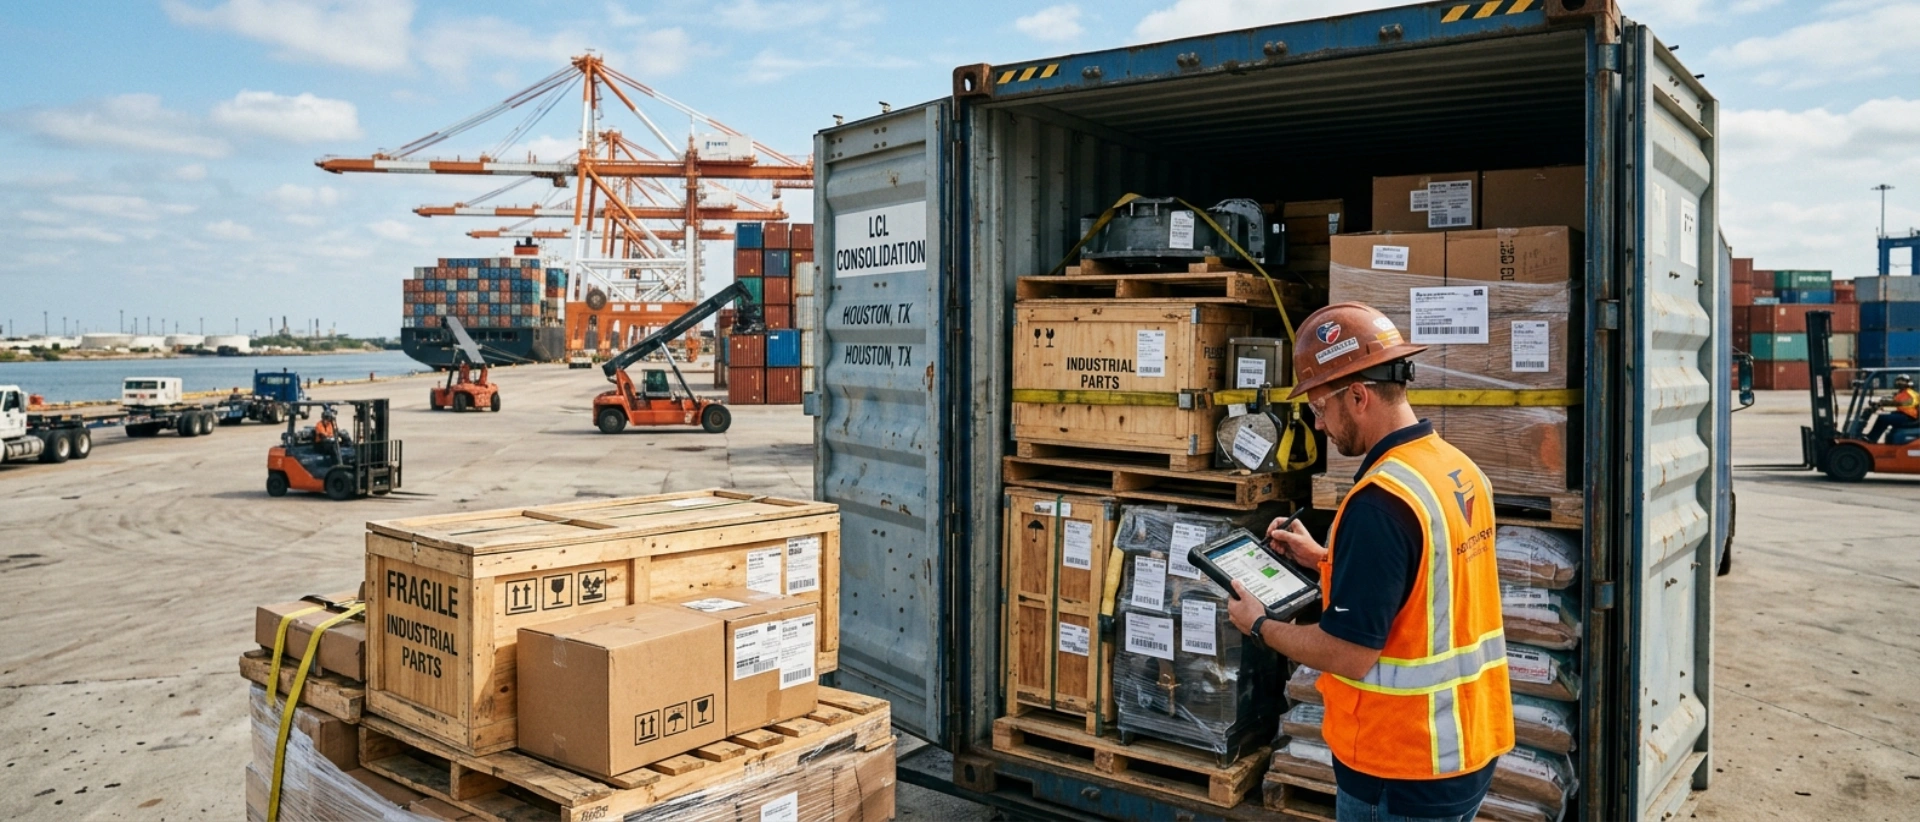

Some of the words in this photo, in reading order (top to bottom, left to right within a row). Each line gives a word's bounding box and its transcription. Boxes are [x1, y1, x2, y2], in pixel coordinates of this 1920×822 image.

[868, 214, 889, 238] LCL
[836, 239, 926, 271] CONSOLIDATION
[842, 303, 893, 327] HOUSTON,
[897, 302, 913, 324] TX
[844, 345, 894, 369] HOUSTON,
[898, 346, 912, 367] TX
[1066, 356, 1136, 373] INDUSTRIAL
[1080, 374, 1120, 390] PARTS
[387, 569, 458, 619] FRAGILE
[387, 613, 458, 656] INDUSTRIAL
[402, 645, 442, 678] PARTS
